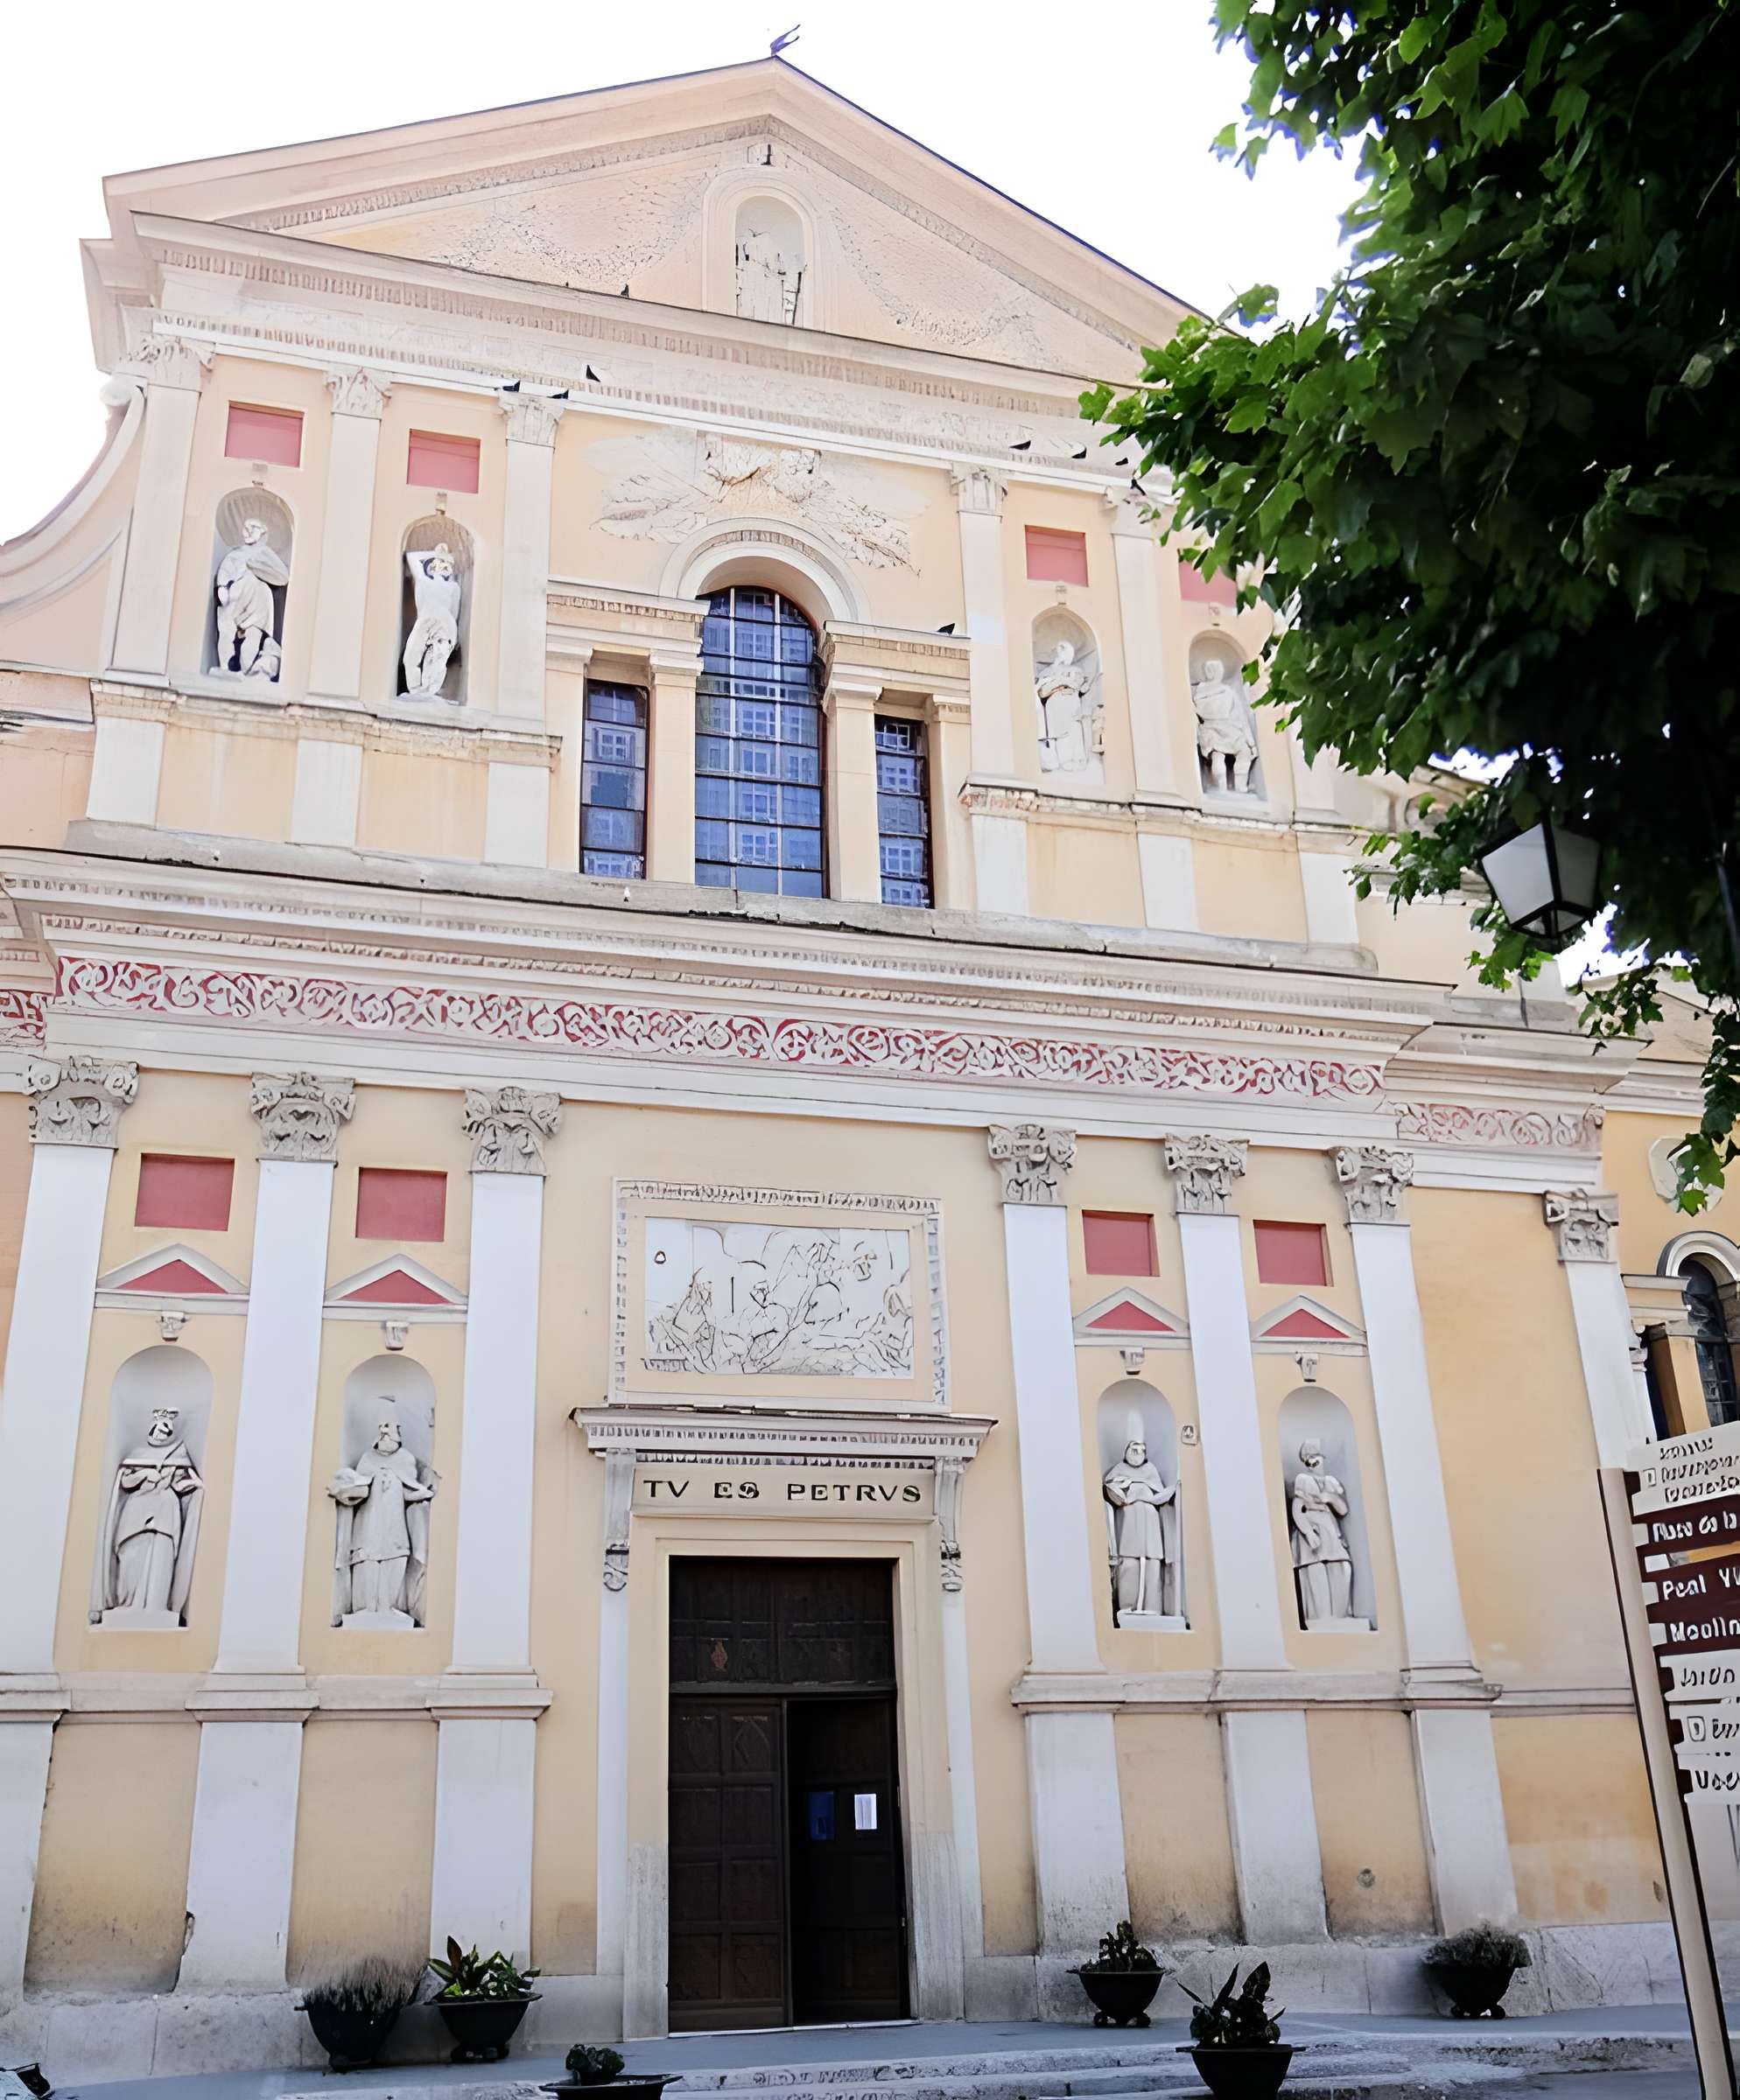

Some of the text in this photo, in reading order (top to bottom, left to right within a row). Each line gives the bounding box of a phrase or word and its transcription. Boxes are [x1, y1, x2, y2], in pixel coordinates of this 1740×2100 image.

[643, 1480, 922, 1502] TV ES PETRVS
